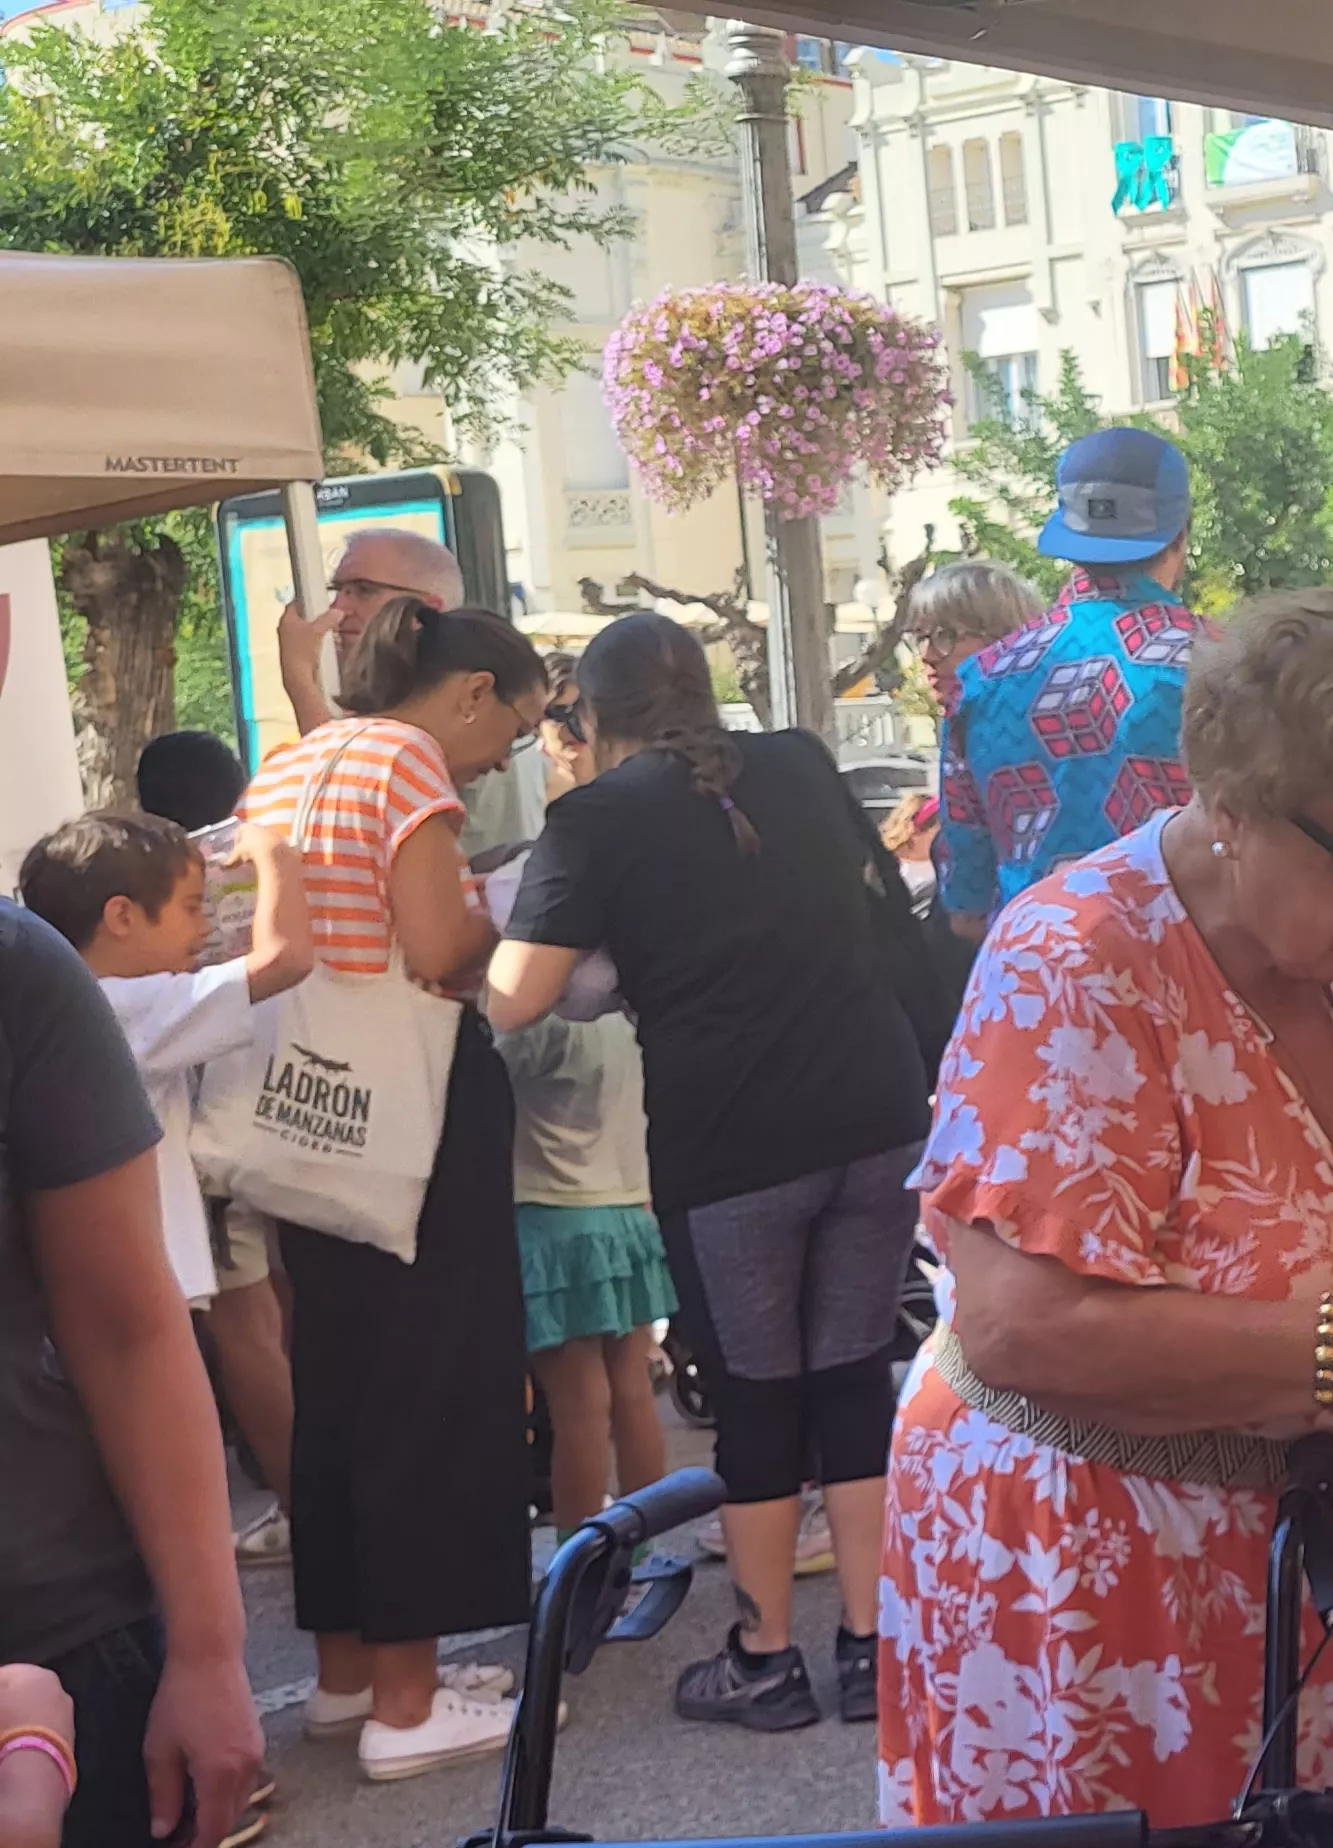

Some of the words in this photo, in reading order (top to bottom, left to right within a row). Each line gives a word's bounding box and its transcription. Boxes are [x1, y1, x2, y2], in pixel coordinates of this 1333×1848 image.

[104, 456, 241, 474] MASTERTENT
[263, 1053, 371, 1122] LADRÓN
[255, 1094, 276, 1119] DE
[276, 1101, 366, 1148] MANZANAS
